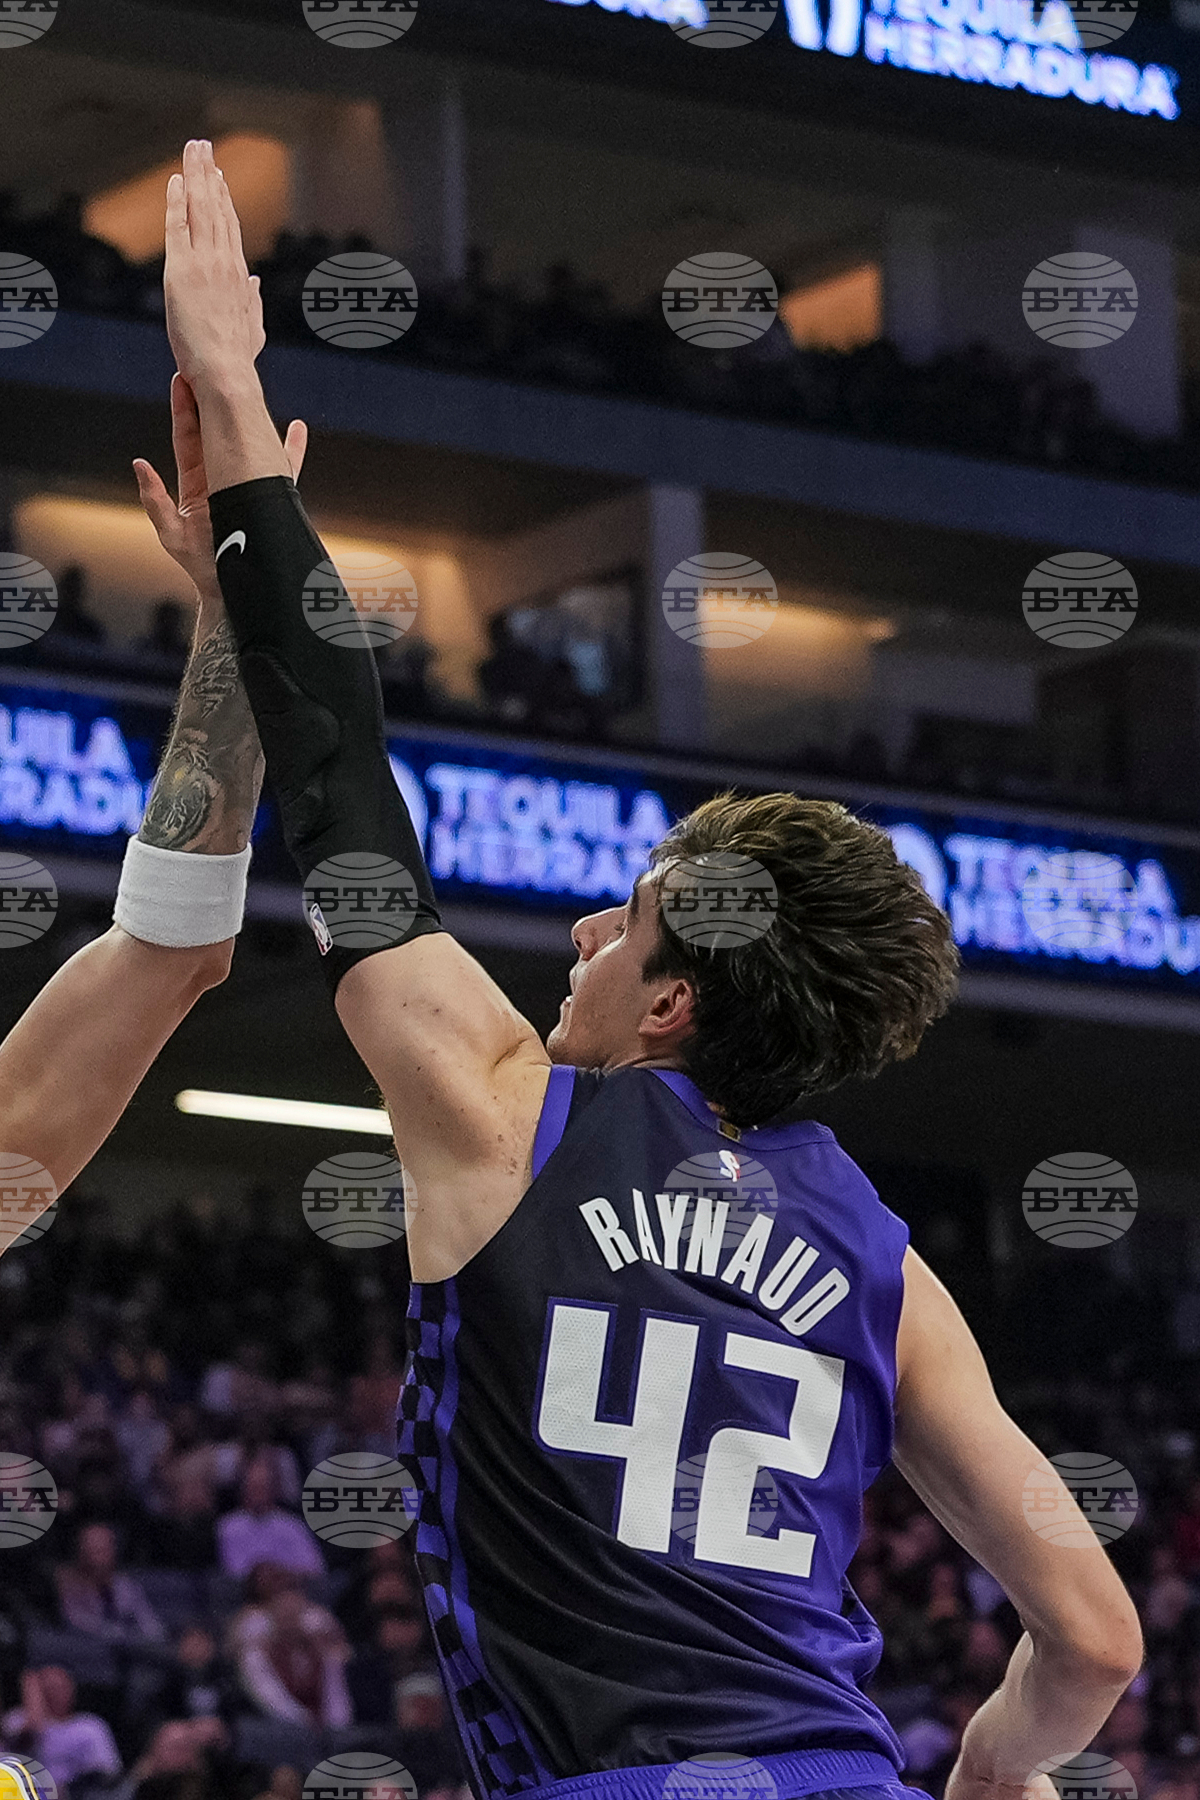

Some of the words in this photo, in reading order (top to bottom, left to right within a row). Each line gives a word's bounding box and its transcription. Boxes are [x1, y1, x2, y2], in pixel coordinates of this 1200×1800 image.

[864, 11, 1181, 120] HERRADURA
[578, 1188, 850, 1336] RAYNAUD
[539, 1304, 846, 1578] 42
